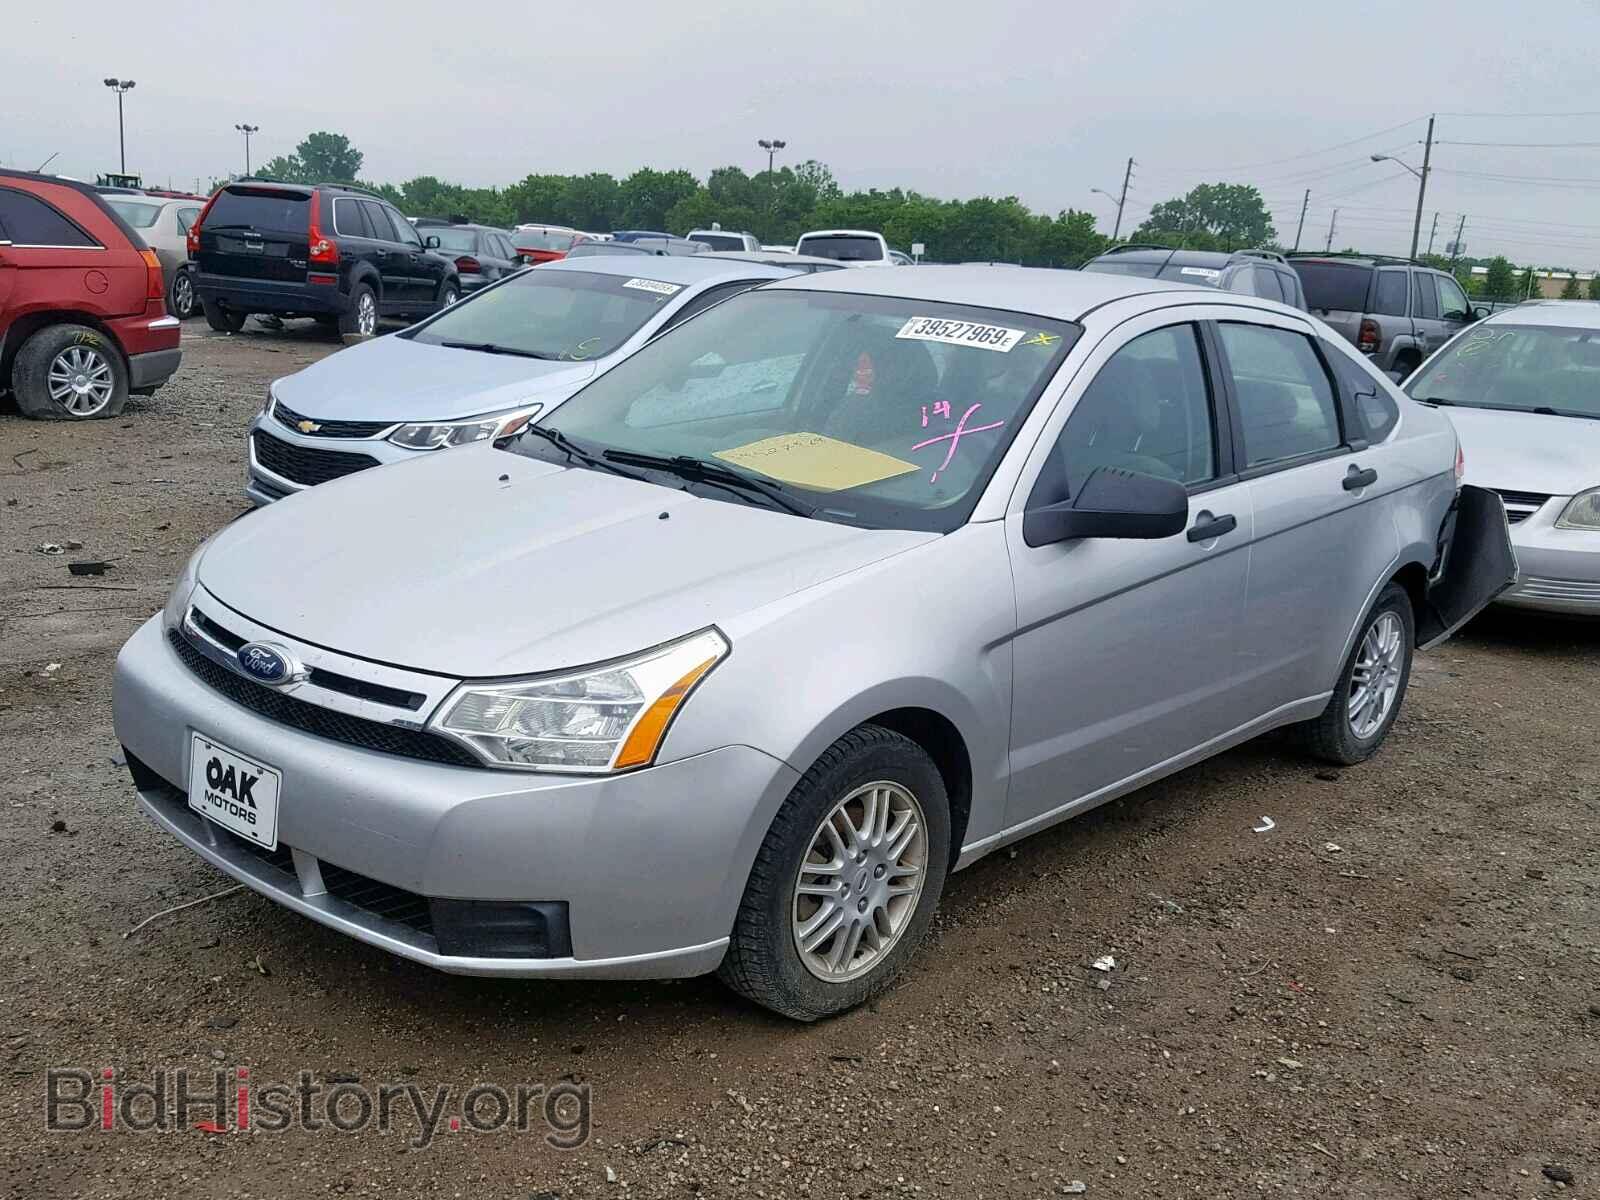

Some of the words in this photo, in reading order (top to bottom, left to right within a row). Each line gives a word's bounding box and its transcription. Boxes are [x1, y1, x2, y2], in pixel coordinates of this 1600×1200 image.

[914, 319, 1007, 346] 39527969
[244, 648, 277, 675] Ford
[206, 757, 259, 810] OAK
[205, 789, 257, 825] MOTORS
